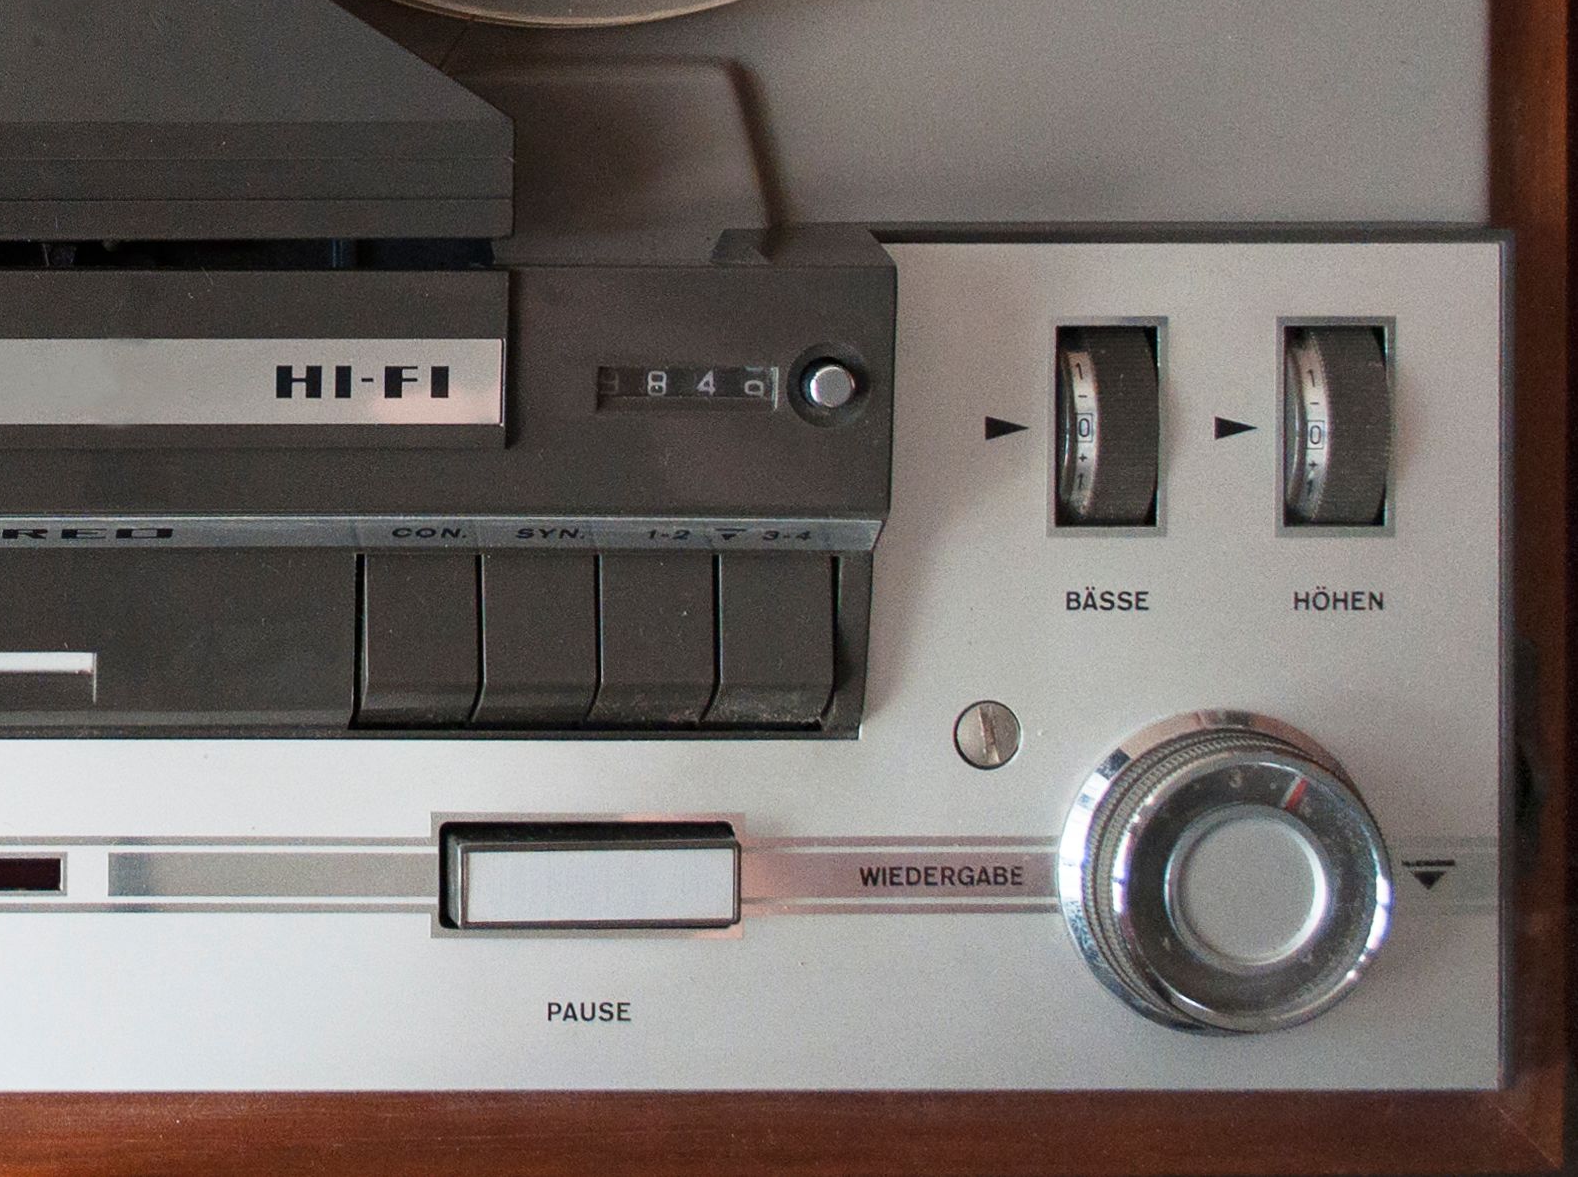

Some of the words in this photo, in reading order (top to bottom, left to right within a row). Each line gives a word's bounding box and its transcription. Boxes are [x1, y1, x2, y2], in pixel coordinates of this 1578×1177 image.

[275, 364, 451, 399] HI-FI
[391, 526, 468, 540] CON.
[515, 527, 586, 540] SYN.
[647, 529, 691, 542] 1-2
[762, 530, 813, 542] 3-4
[1065, 585, 1151, 613] BÄSSE
[1293, 585, 1385, 613] HÖHEN
[858, 865, 1024, 888] WIEDERGABE
[546, 1001, 632, 1023] PAUSE
